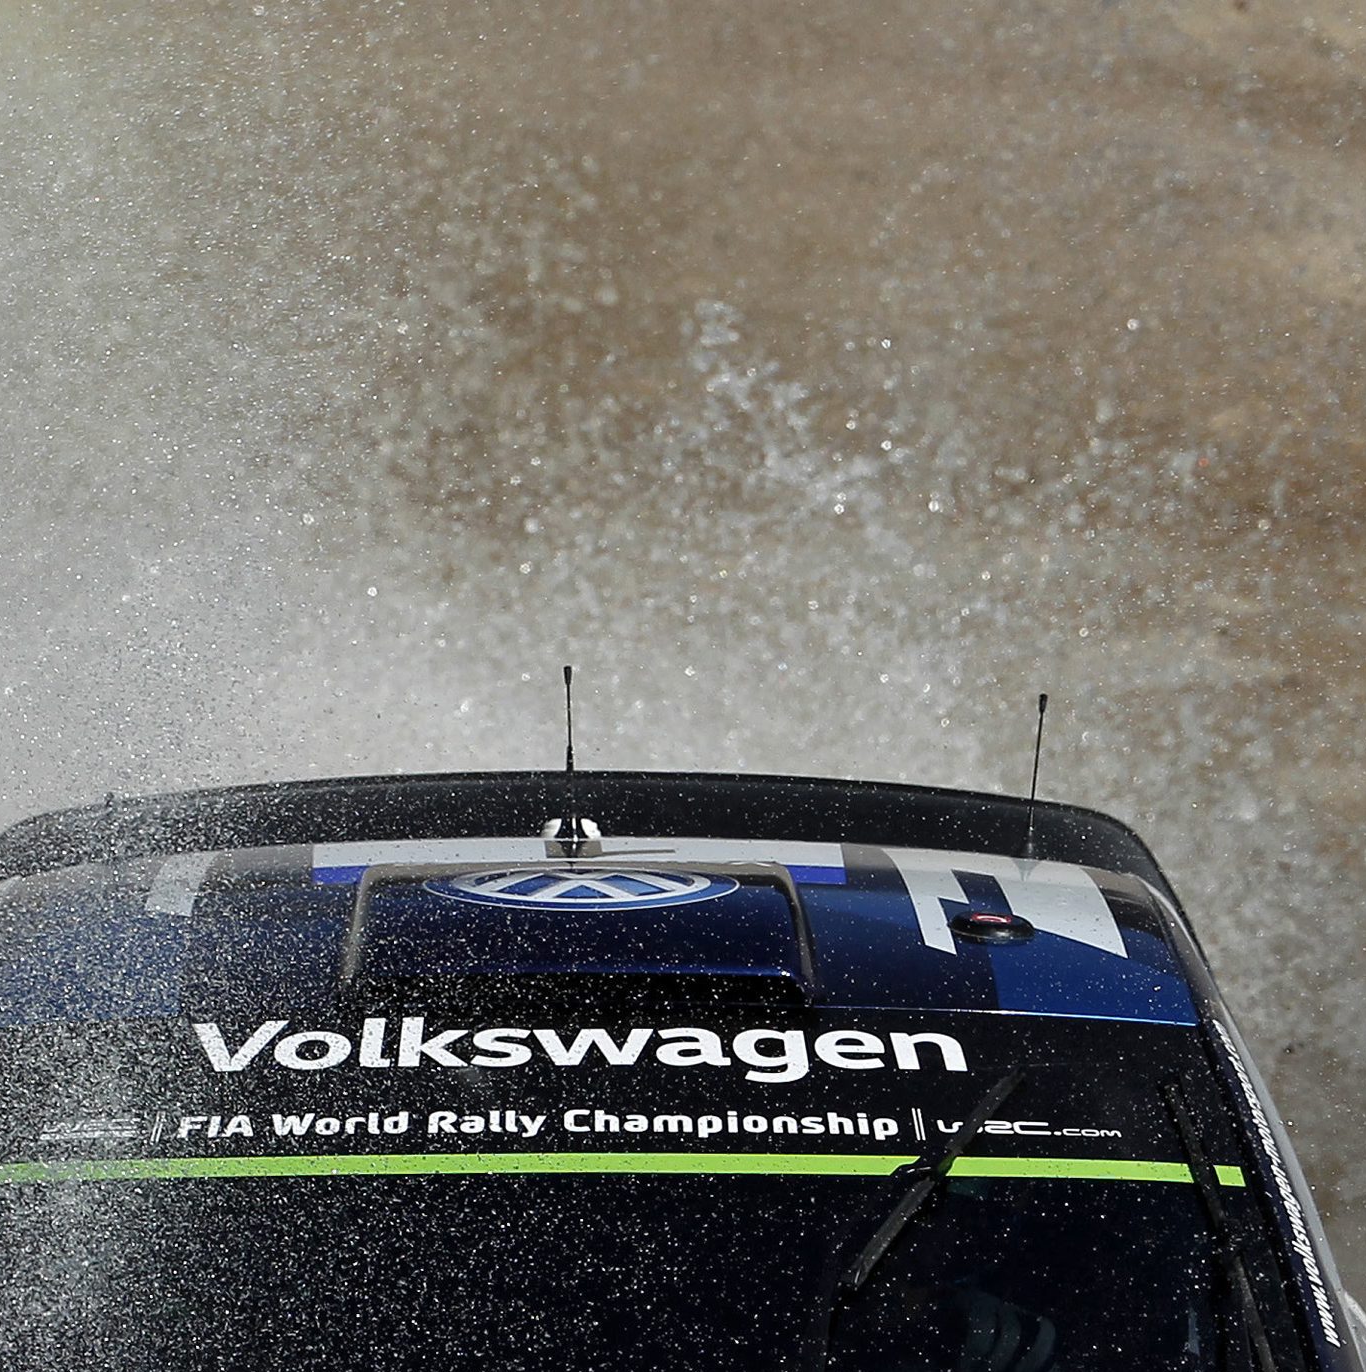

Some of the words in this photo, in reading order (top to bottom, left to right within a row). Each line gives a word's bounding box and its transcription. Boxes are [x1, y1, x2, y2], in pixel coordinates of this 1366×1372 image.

[191, 1017, 968, 1082] Volkswagen
[177, 1115, 254, 1139] FIA
[272, 1112, 409, 1136] World
[428, 1110, 547, 1137] Rally
[563, 1109, 898, 1139] Championship
[1212, 1018, 1341, 1348] www.volkswagen-motorsport.com
